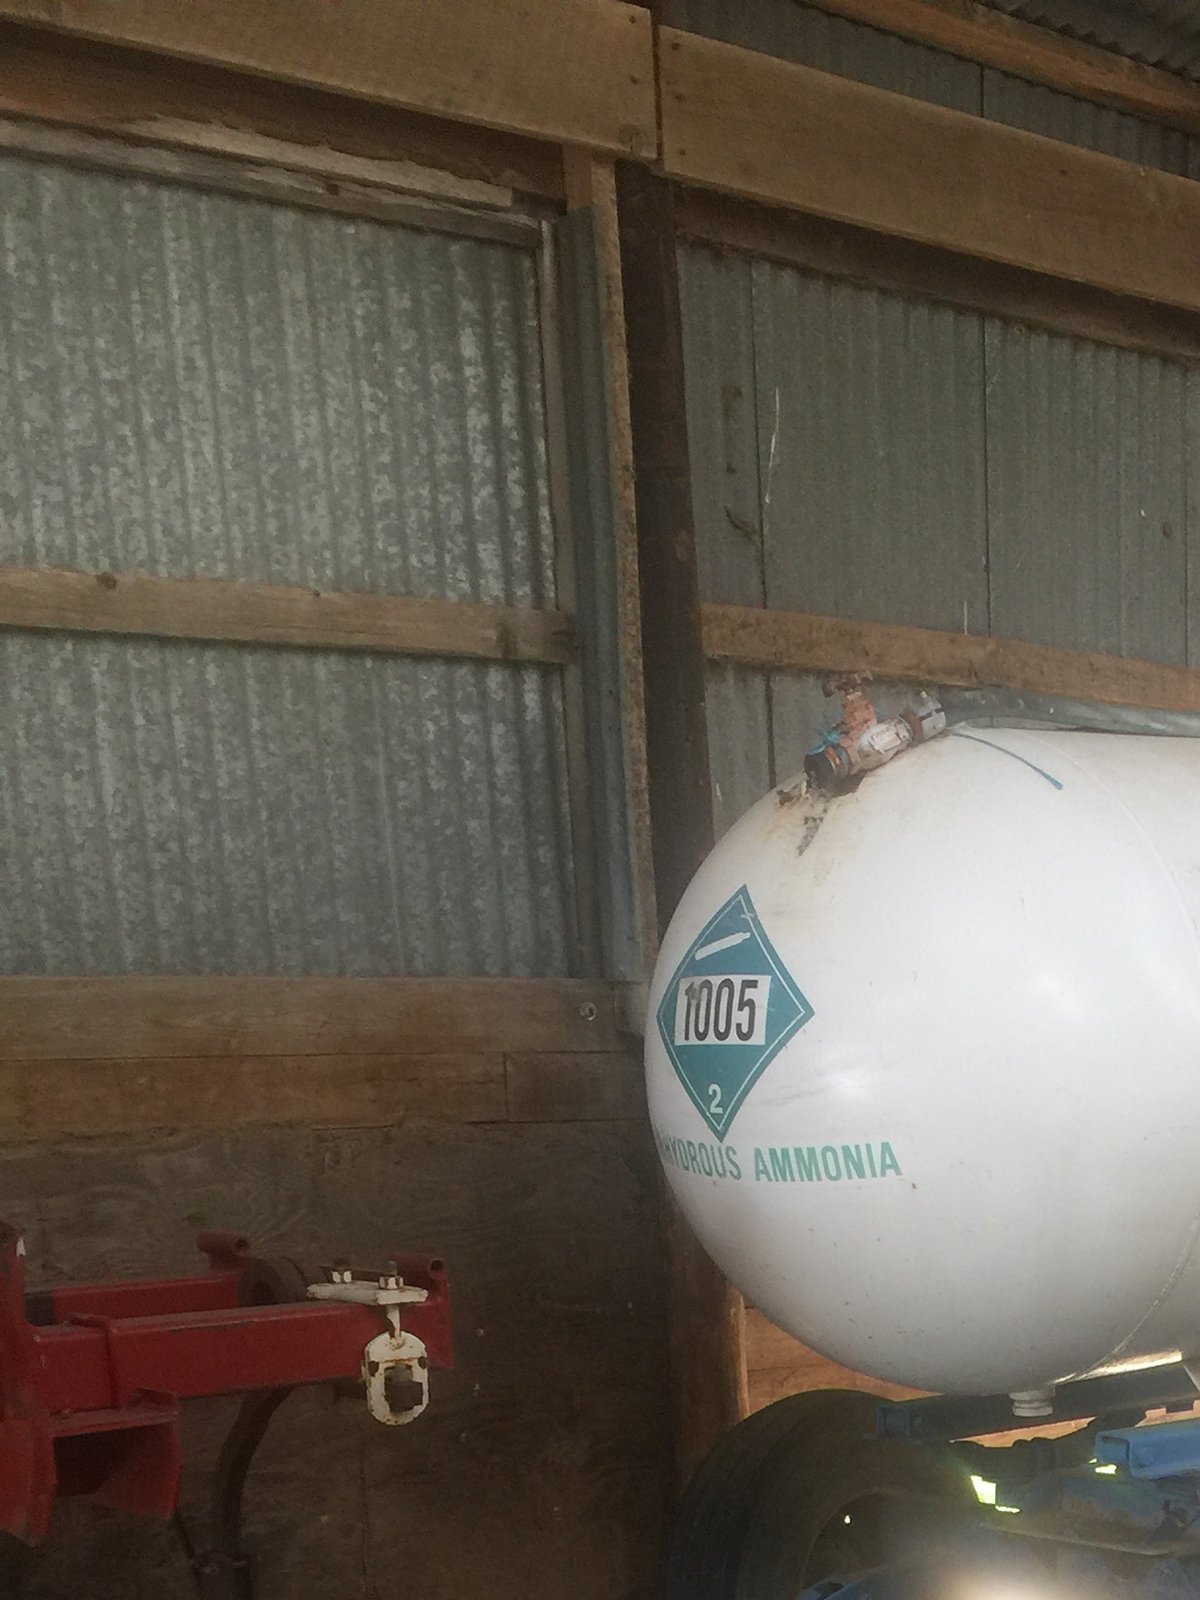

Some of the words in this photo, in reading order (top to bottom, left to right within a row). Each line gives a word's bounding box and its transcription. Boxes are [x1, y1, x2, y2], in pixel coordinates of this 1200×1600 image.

[684, 978, 759, 1042] 1005
[708, 1083, 724, 1114] 2
[754, 1141, 903, 1183] AMMONIA
